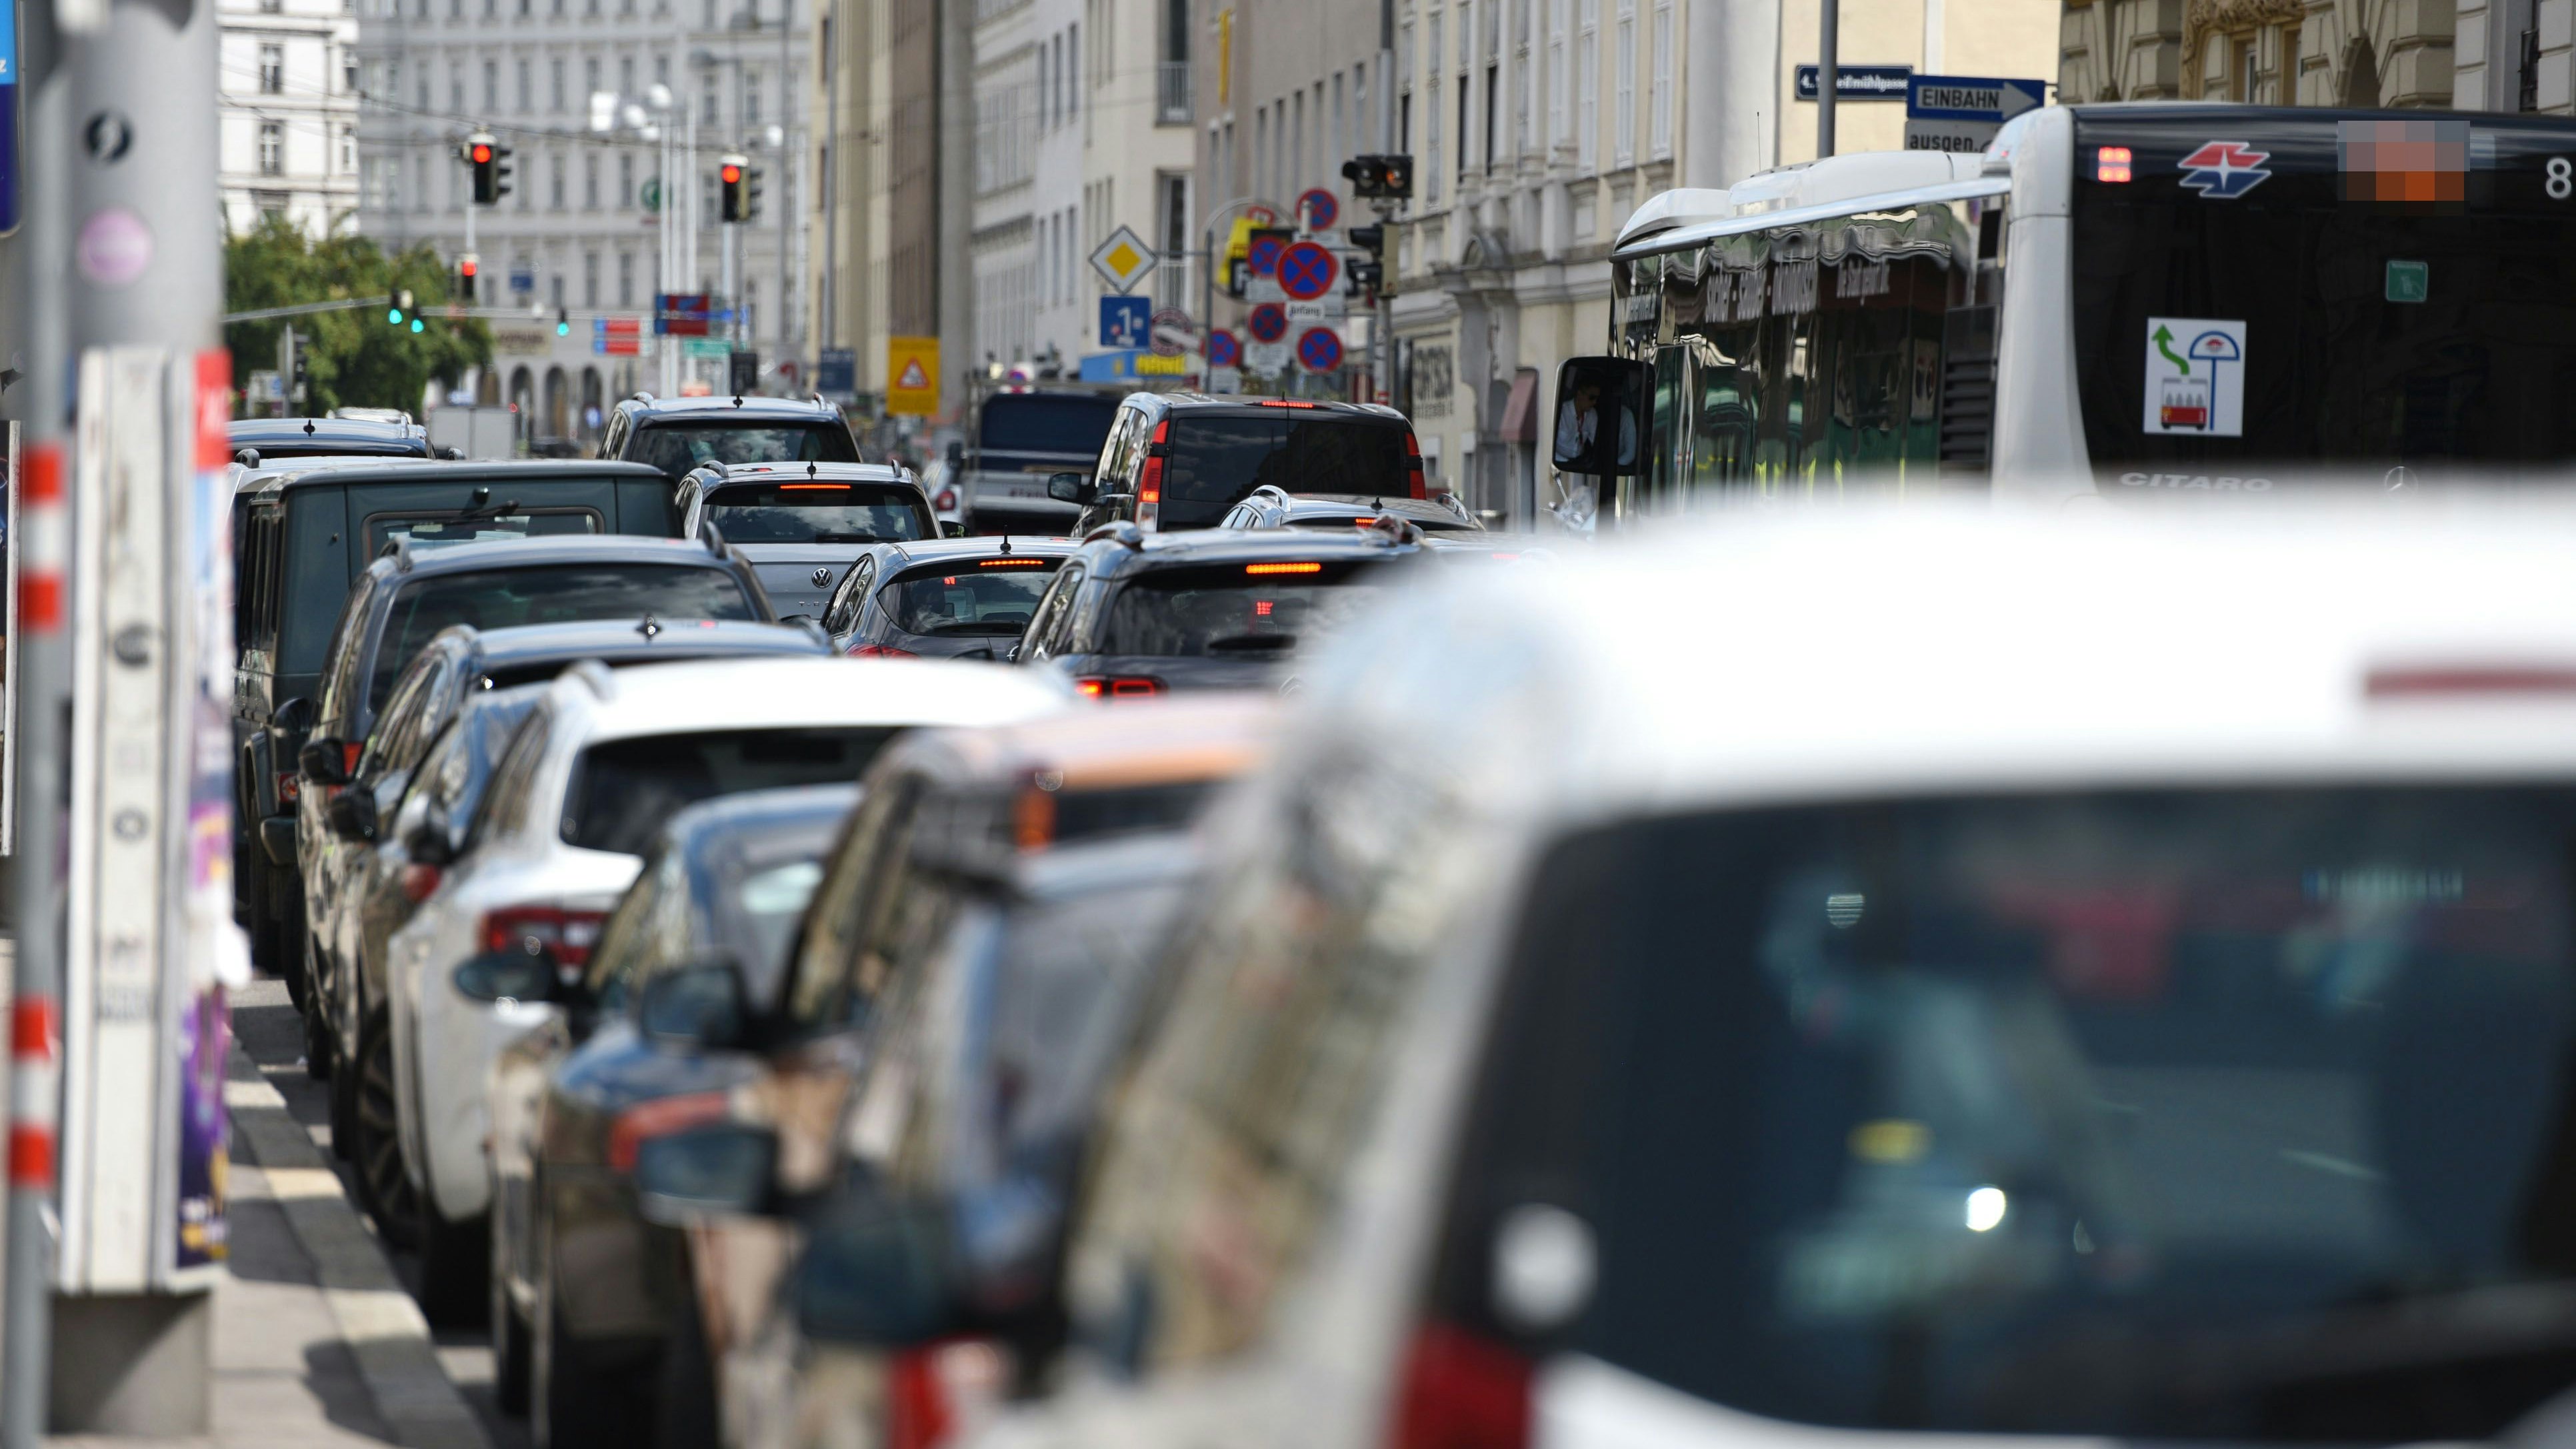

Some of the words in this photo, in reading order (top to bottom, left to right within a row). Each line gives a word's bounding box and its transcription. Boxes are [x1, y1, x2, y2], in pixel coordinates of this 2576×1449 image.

[1922, 88, 1999, 109] EINBAHN
[1910, 134, 1979, 152] ausgen.
[2546, 157, 2572, 199] 8
[2119, 472, 2273, 492] CITARO
